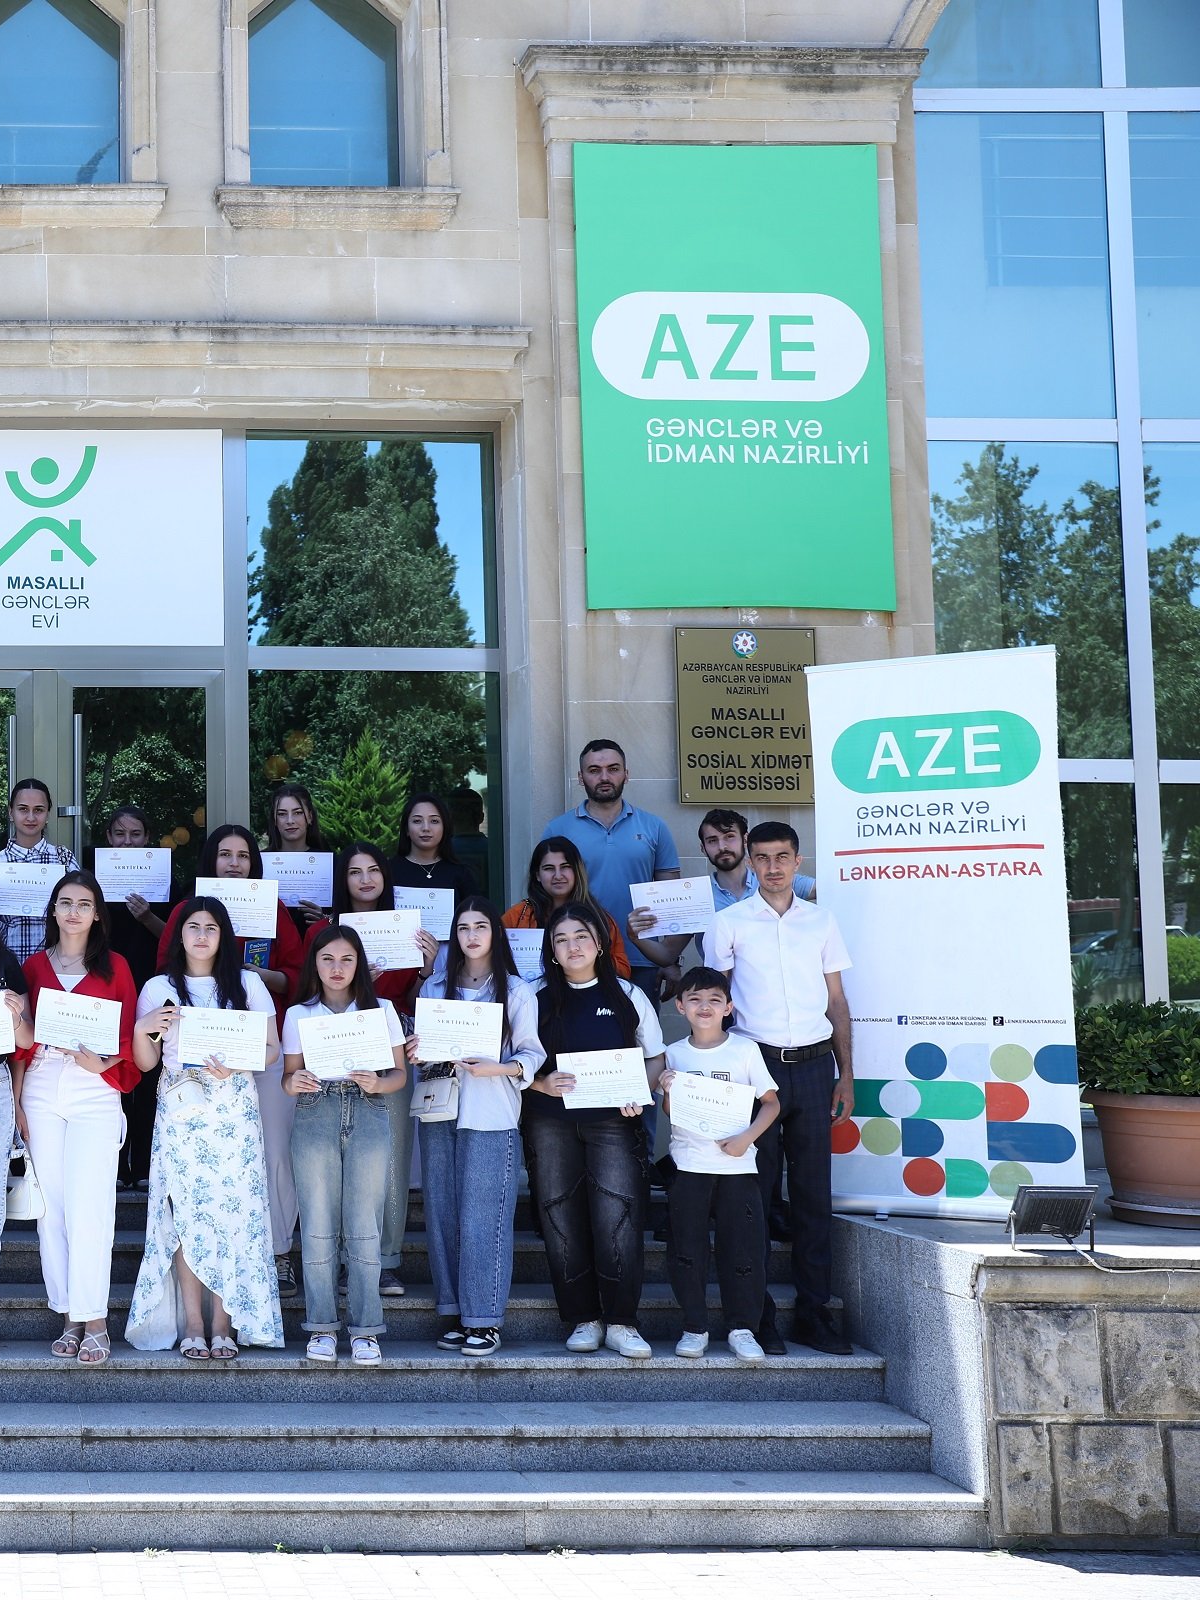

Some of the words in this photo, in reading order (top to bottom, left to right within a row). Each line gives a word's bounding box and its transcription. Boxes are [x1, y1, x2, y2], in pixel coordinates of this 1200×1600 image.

[640, 313, 816, 381] AZE
[646, 418, 778, 438] GƏNCLƏR
[785, 419, 822, 439] VƏ
[647, 439, 735, 464] İDMAN
[744, 440, 868, 464] NAZİRLİYİ
[7, 576, 84, 590] MASALLI
[2, 595, 90, 609] GƏNCLƏR
[32, 612, 59, 628] EVİ
[682, 663, 743, 672] AZƏRBAYCAN
[746, 661, 810, 672] RESPUBLİKA
[702, 675, 746, 683] GƏNCLƏR
[748, 675, 761, 683] VƏ
[762, 673, 792, 683] İDMAN
[726, 685, 769, 695] NAZİRLİYİ
[712, 708, 785, 720] MASALLI
[691, 726, 774, 739] GƏNCLƏR
[780, 724, 806, 740] EVİ
[687, 751, 746, 769] SOSİAL
[751, 751, 812, 769] XİDMƏT
[866, 724, 1002, 780] AZE
[700, 772, 800, 790] MÜƏSSİSƏSİ
[856, 802, 954, 820] GƏNCLƏR
[962, 800, 990, 815] VƏ
[857, 821, 921, 838] İDMAN
[928, 815, 1026, 835] NAZİRLİYİ
[840, 861, 1042, 882] LƏNKƏRAN-ASTARA
